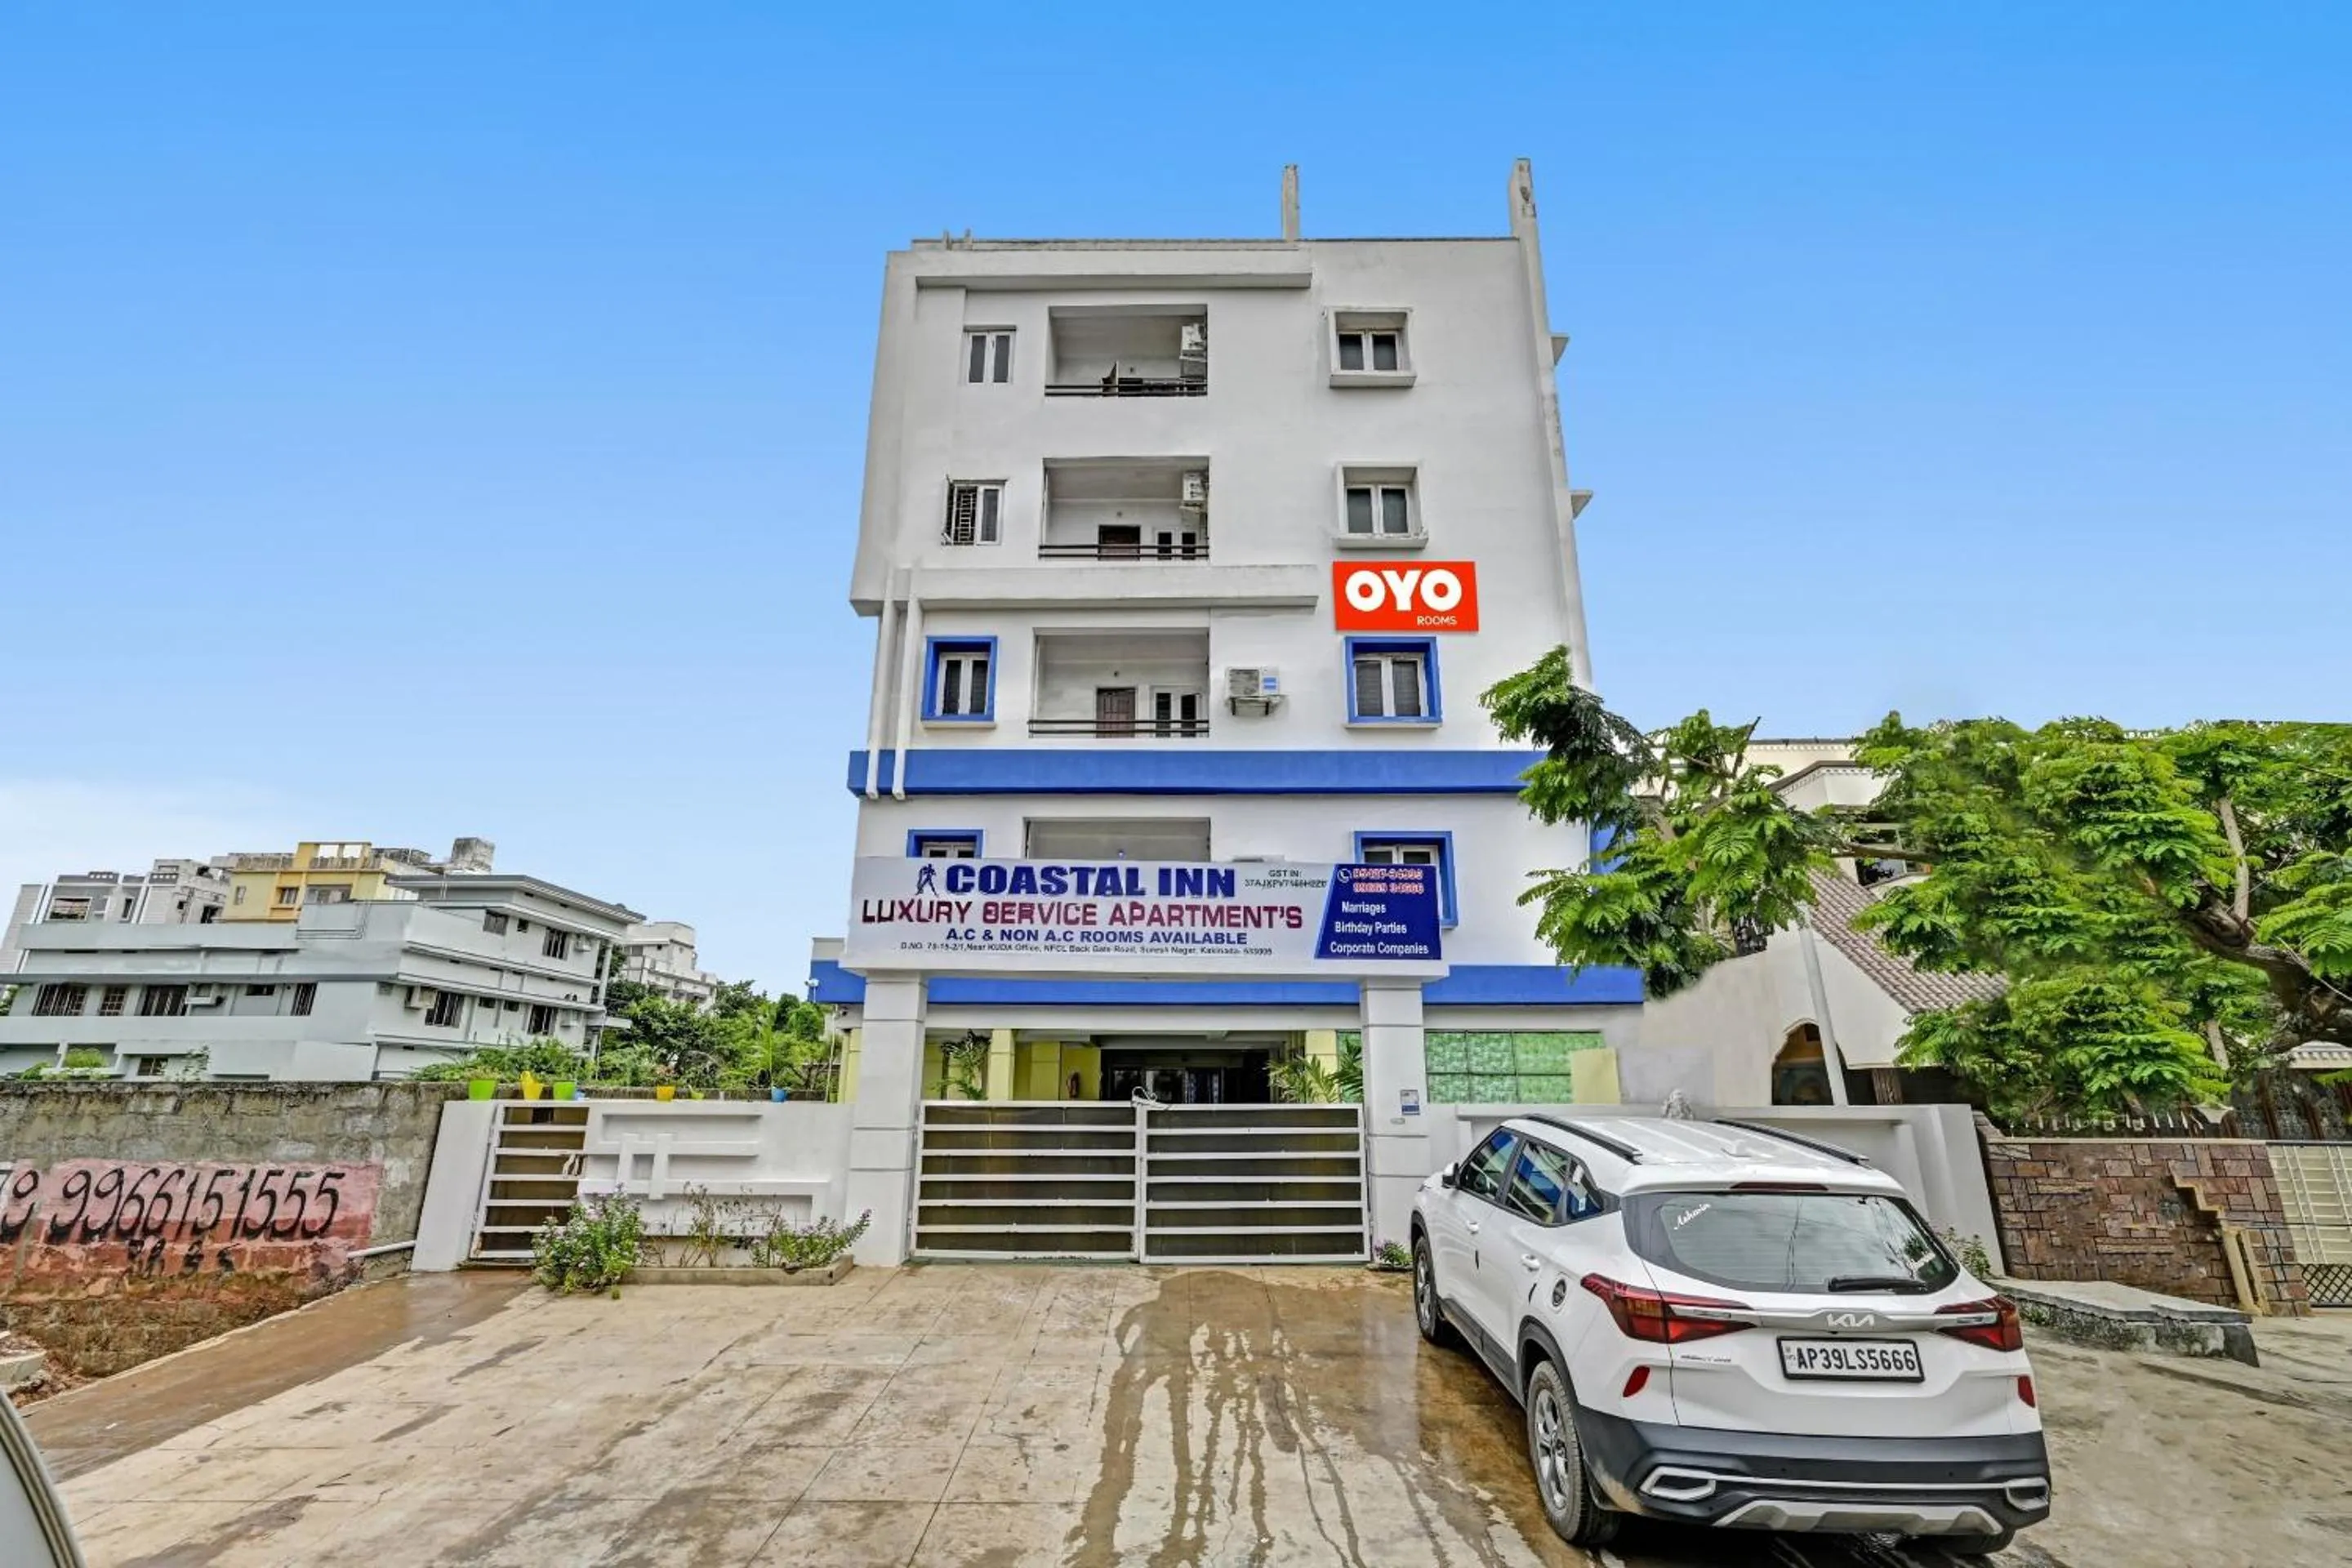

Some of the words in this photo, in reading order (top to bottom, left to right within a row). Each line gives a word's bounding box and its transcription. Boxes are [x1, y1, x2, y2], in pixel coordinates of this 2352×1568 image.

[1345, 569, 1462, 612] OYO
[1417, 615, 1458, 626] ROOMS
[946, 864, 1147, 897] COASTAL
[1158, 867, 1236, 898] INN
[1268, 869, 1288, 878] GST
[862, 899, 973, 924] LUXURY
[982, 902, 1098, 926] SERVICE
[1108, 902, 1303, 929] APARTMENT'S
[1342, 901, 1387, 915] Marriages
[946, 928, 976, 941] A.C
[982, 929, 994, 941] &
[1000, 929, 1039, 942] NON
[1045, 929, 1074, 942] A.C
[1080, 930, 1143, 943] ROOMS
[1150, 931, 1248, 945] AVAILABLE
[1334, 921, 1373, 936] Birthday
[1374, 921, 1407, 933] Parties
[1330, 941, 1375, 956] Corporate
[1378, 942, 1429, 956] Companies
[47, 1168, 345, 1244] 9966151555
[1826, 1313, 1875, 1327] KIA
[1797, 1348, 1916, 1370] AP39LS5666
